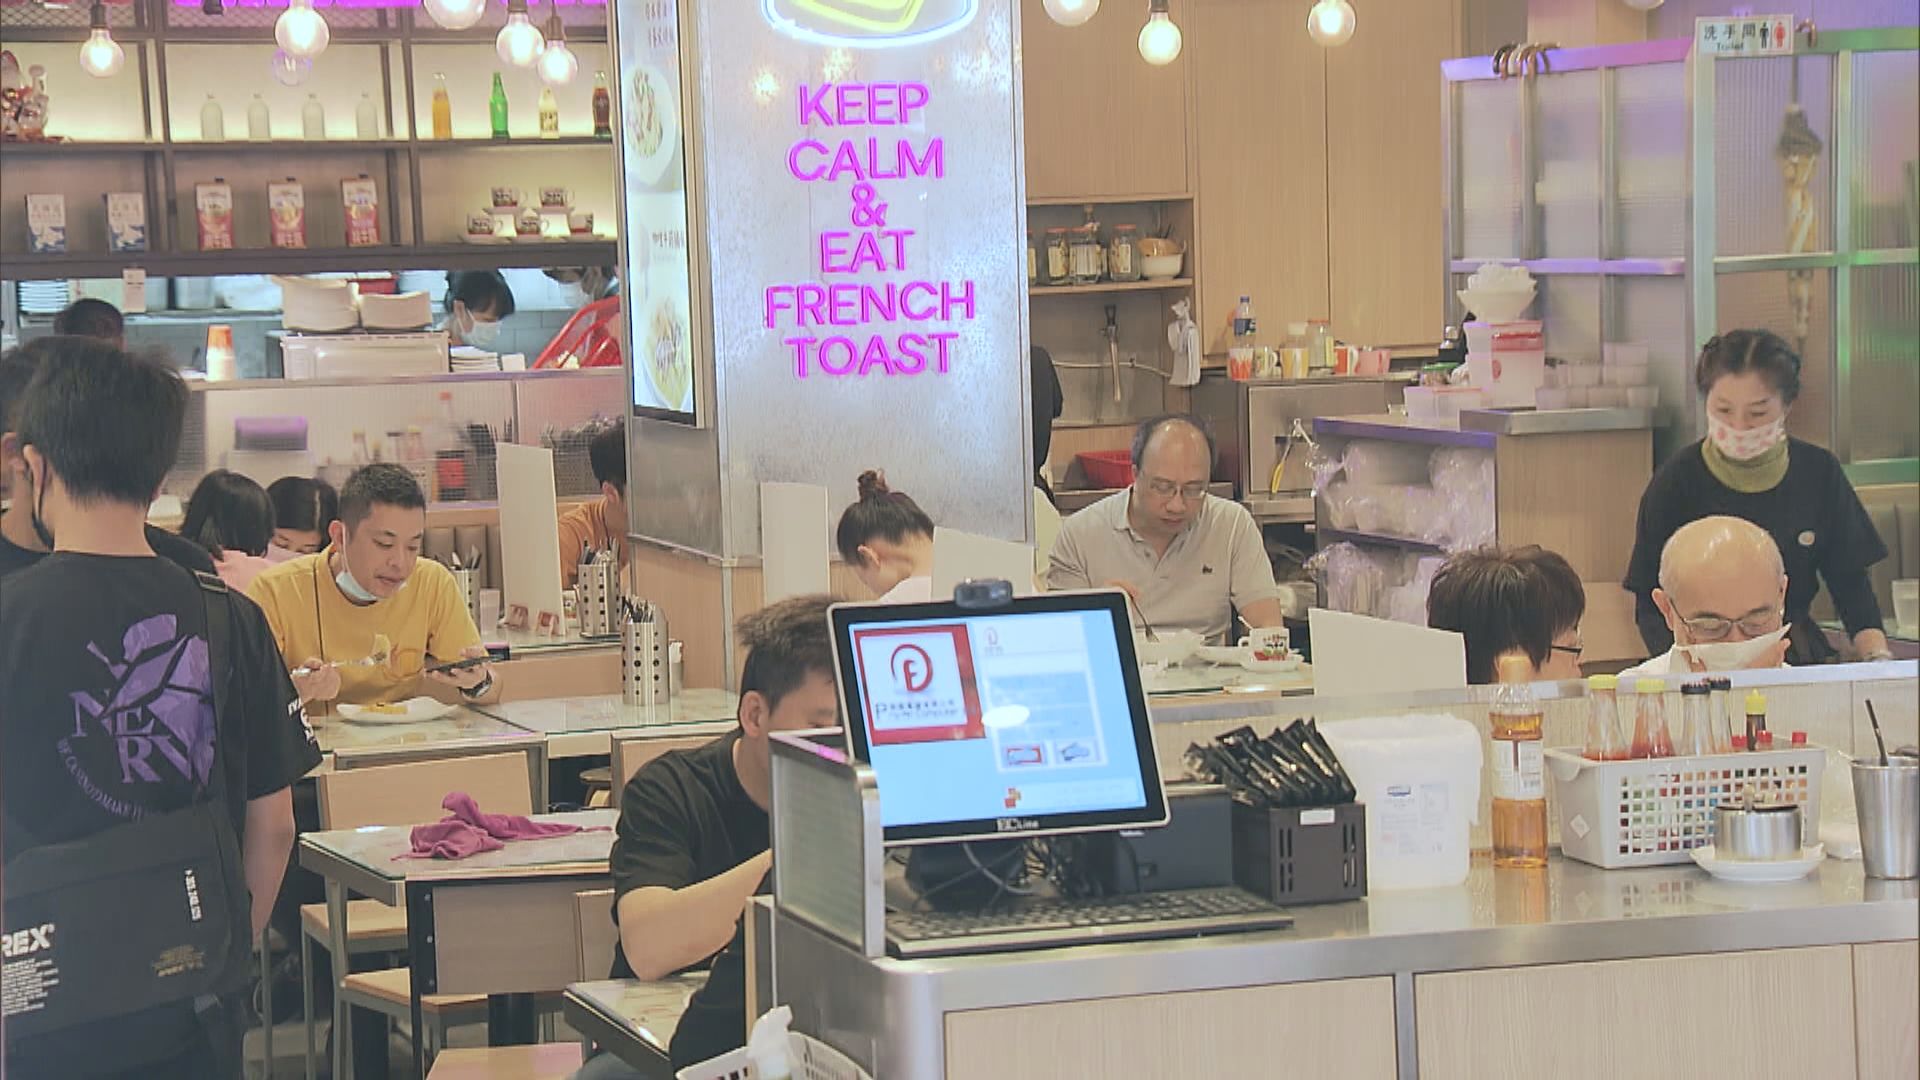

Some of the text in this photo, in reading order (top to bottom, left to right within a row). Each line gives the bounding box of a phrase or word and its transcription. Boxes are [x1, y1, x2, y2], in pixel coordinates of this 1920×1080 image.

[799, 83, 929, 126] KEEP
[788, 137, 944, 182] CALM
[851, 183, 888, 227] &
[821, 231, 914, 272] EAT
[765, 281, 975, 329] FRENCH
[785, 332, 959, 378] TOAST
